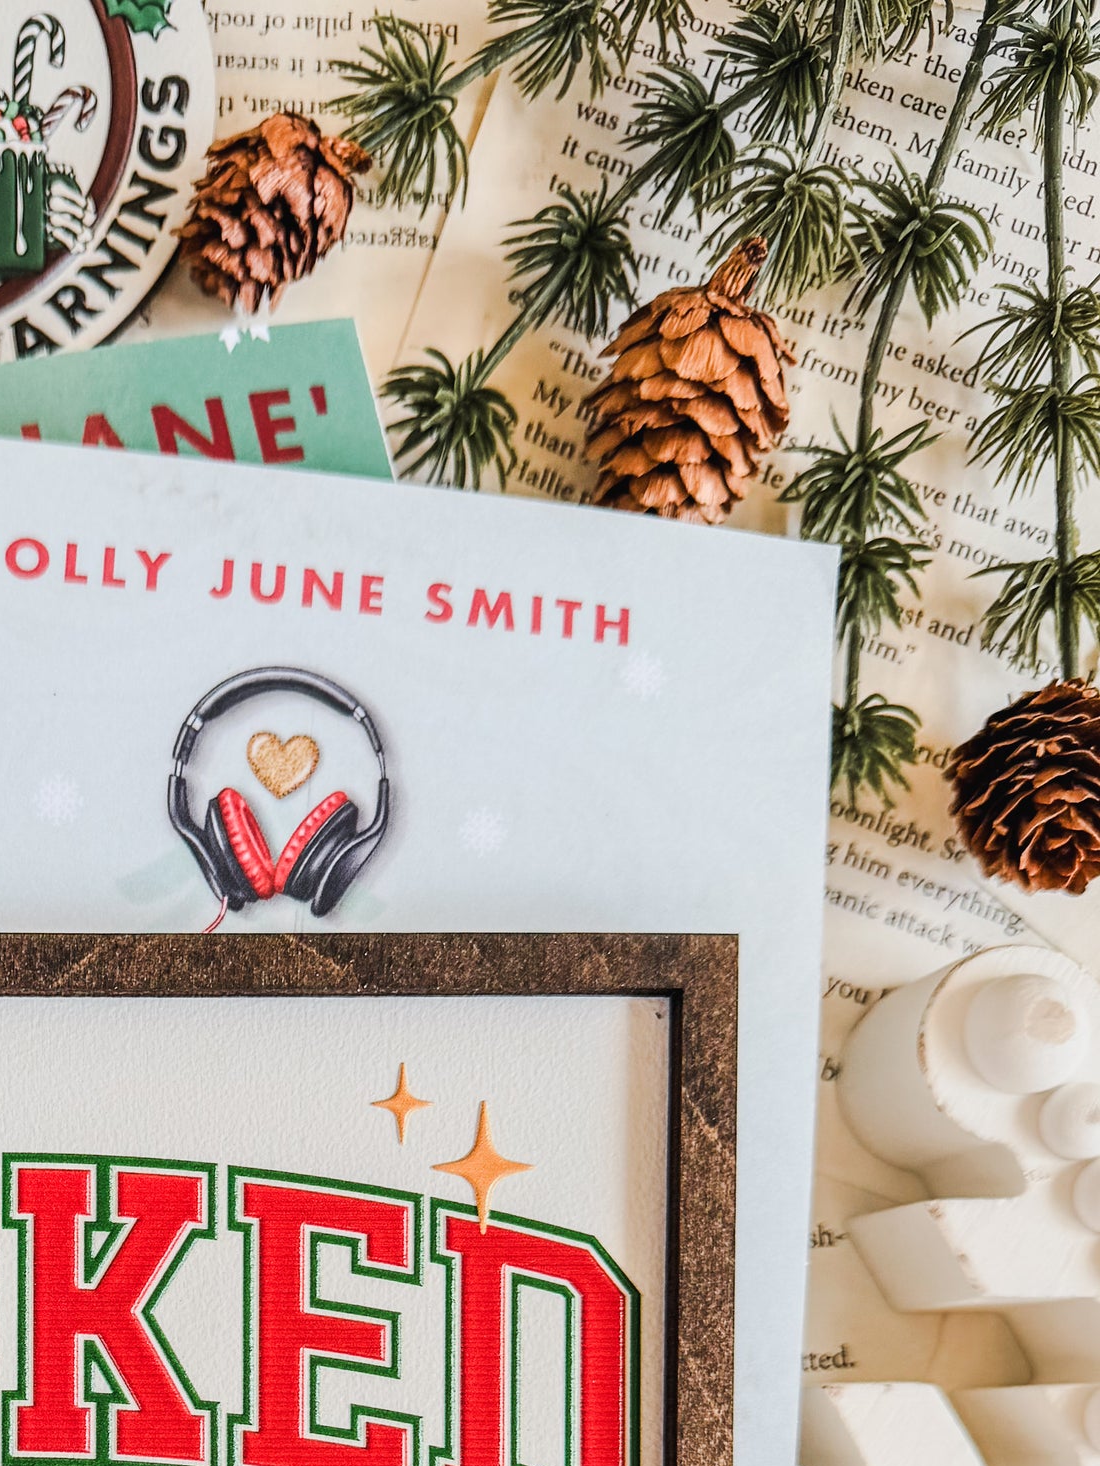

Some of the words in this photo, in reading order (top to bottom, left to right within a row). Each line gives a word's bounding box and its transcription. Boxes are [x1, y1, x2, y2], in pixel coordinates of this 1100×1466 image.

[924, 52, 962, 84] the
[900, 93, 948, 120] care
[560, 135, 580, 159] it
[577, 102, 618, 132] was
[952, 149, 1030, 199] family
[667, 261, 690, 284] to
[911, 353, 979, 388] asked
[532, 380, 572, 418] My
[800, 349, 858, 387] from
[907, 387, 962, 424] beer
[952, 495, 1000, 527] that
[209, 557, 386, 617] JUNE
[423, 581, 633, 648] SMITH
[927, 618, 974, 647] and
[844, 842, 892, 879] him
[884, 907, 955, 947] attack
[822, 976, 869, 1004] you
